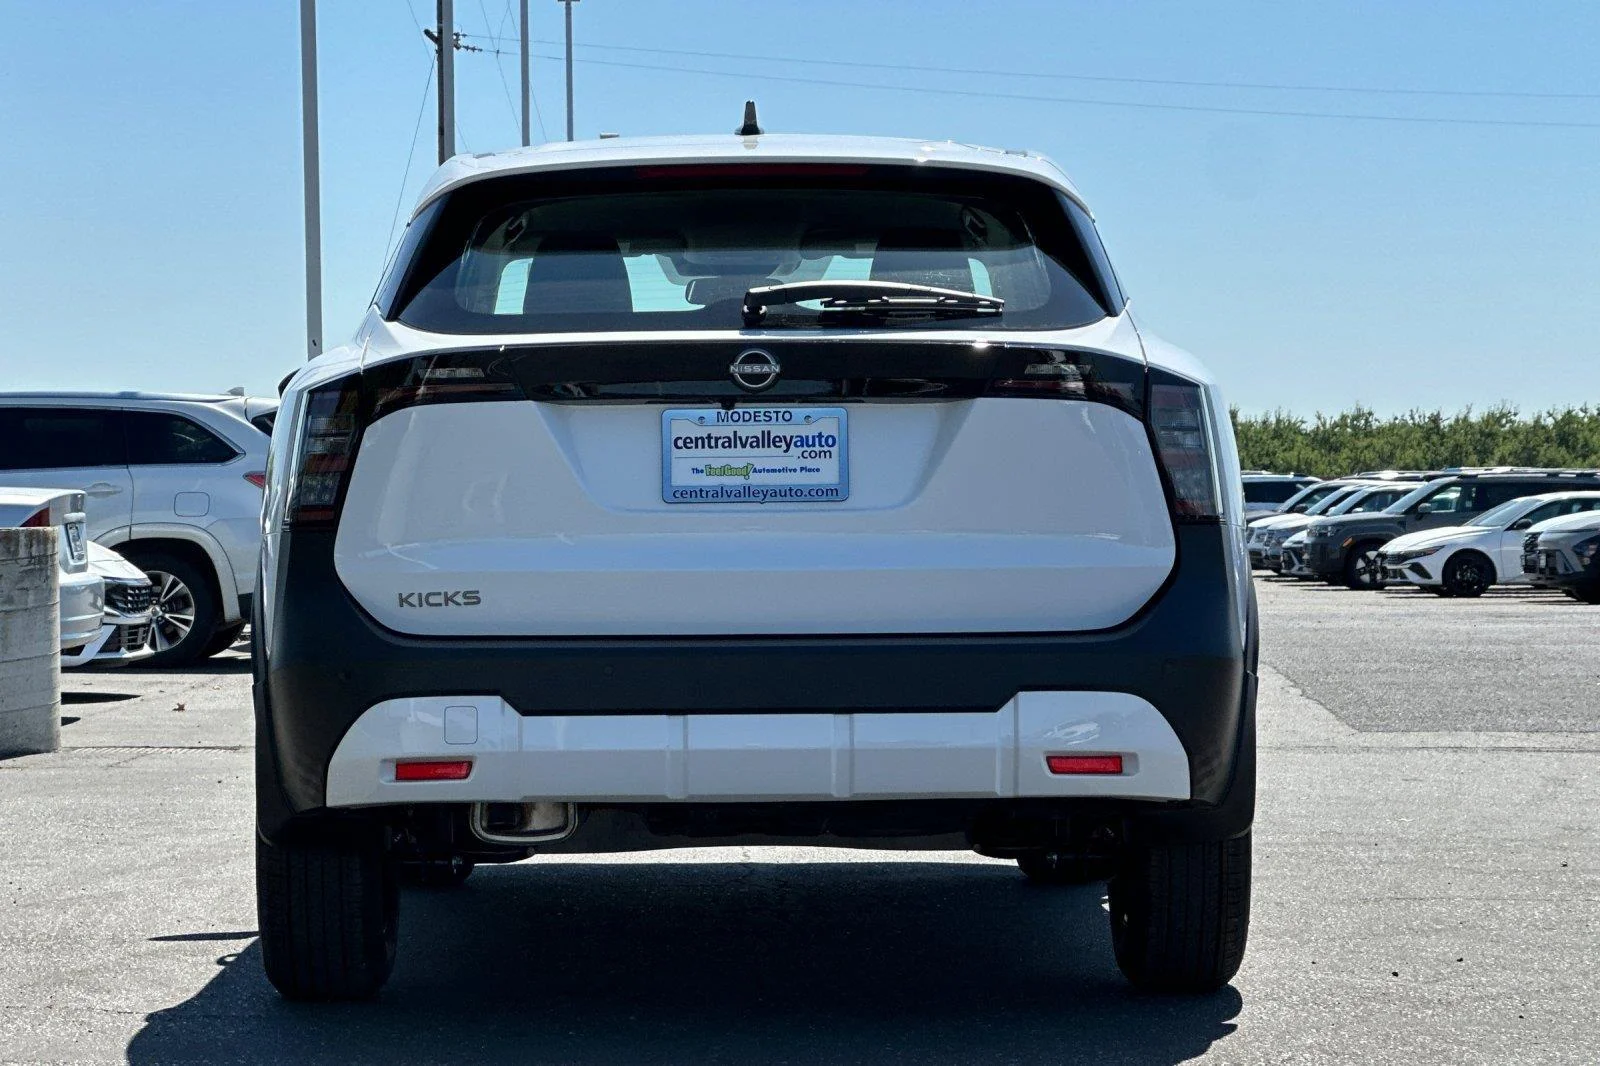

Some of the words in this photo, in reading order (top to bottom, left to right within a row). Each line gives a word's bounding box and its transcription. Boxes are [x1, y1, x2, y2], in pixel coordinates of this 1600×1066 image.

[730, 364, 780, 374] NISSAN
[716, 410, 792, 423] MODESTO
[673, 430, 837, 453] centralvalleyauto
[797, 449, 832, 460] .com
[672, 485, 839, 501] centralvalleyauto.com
[398, 590, 481, 607] KICKS
